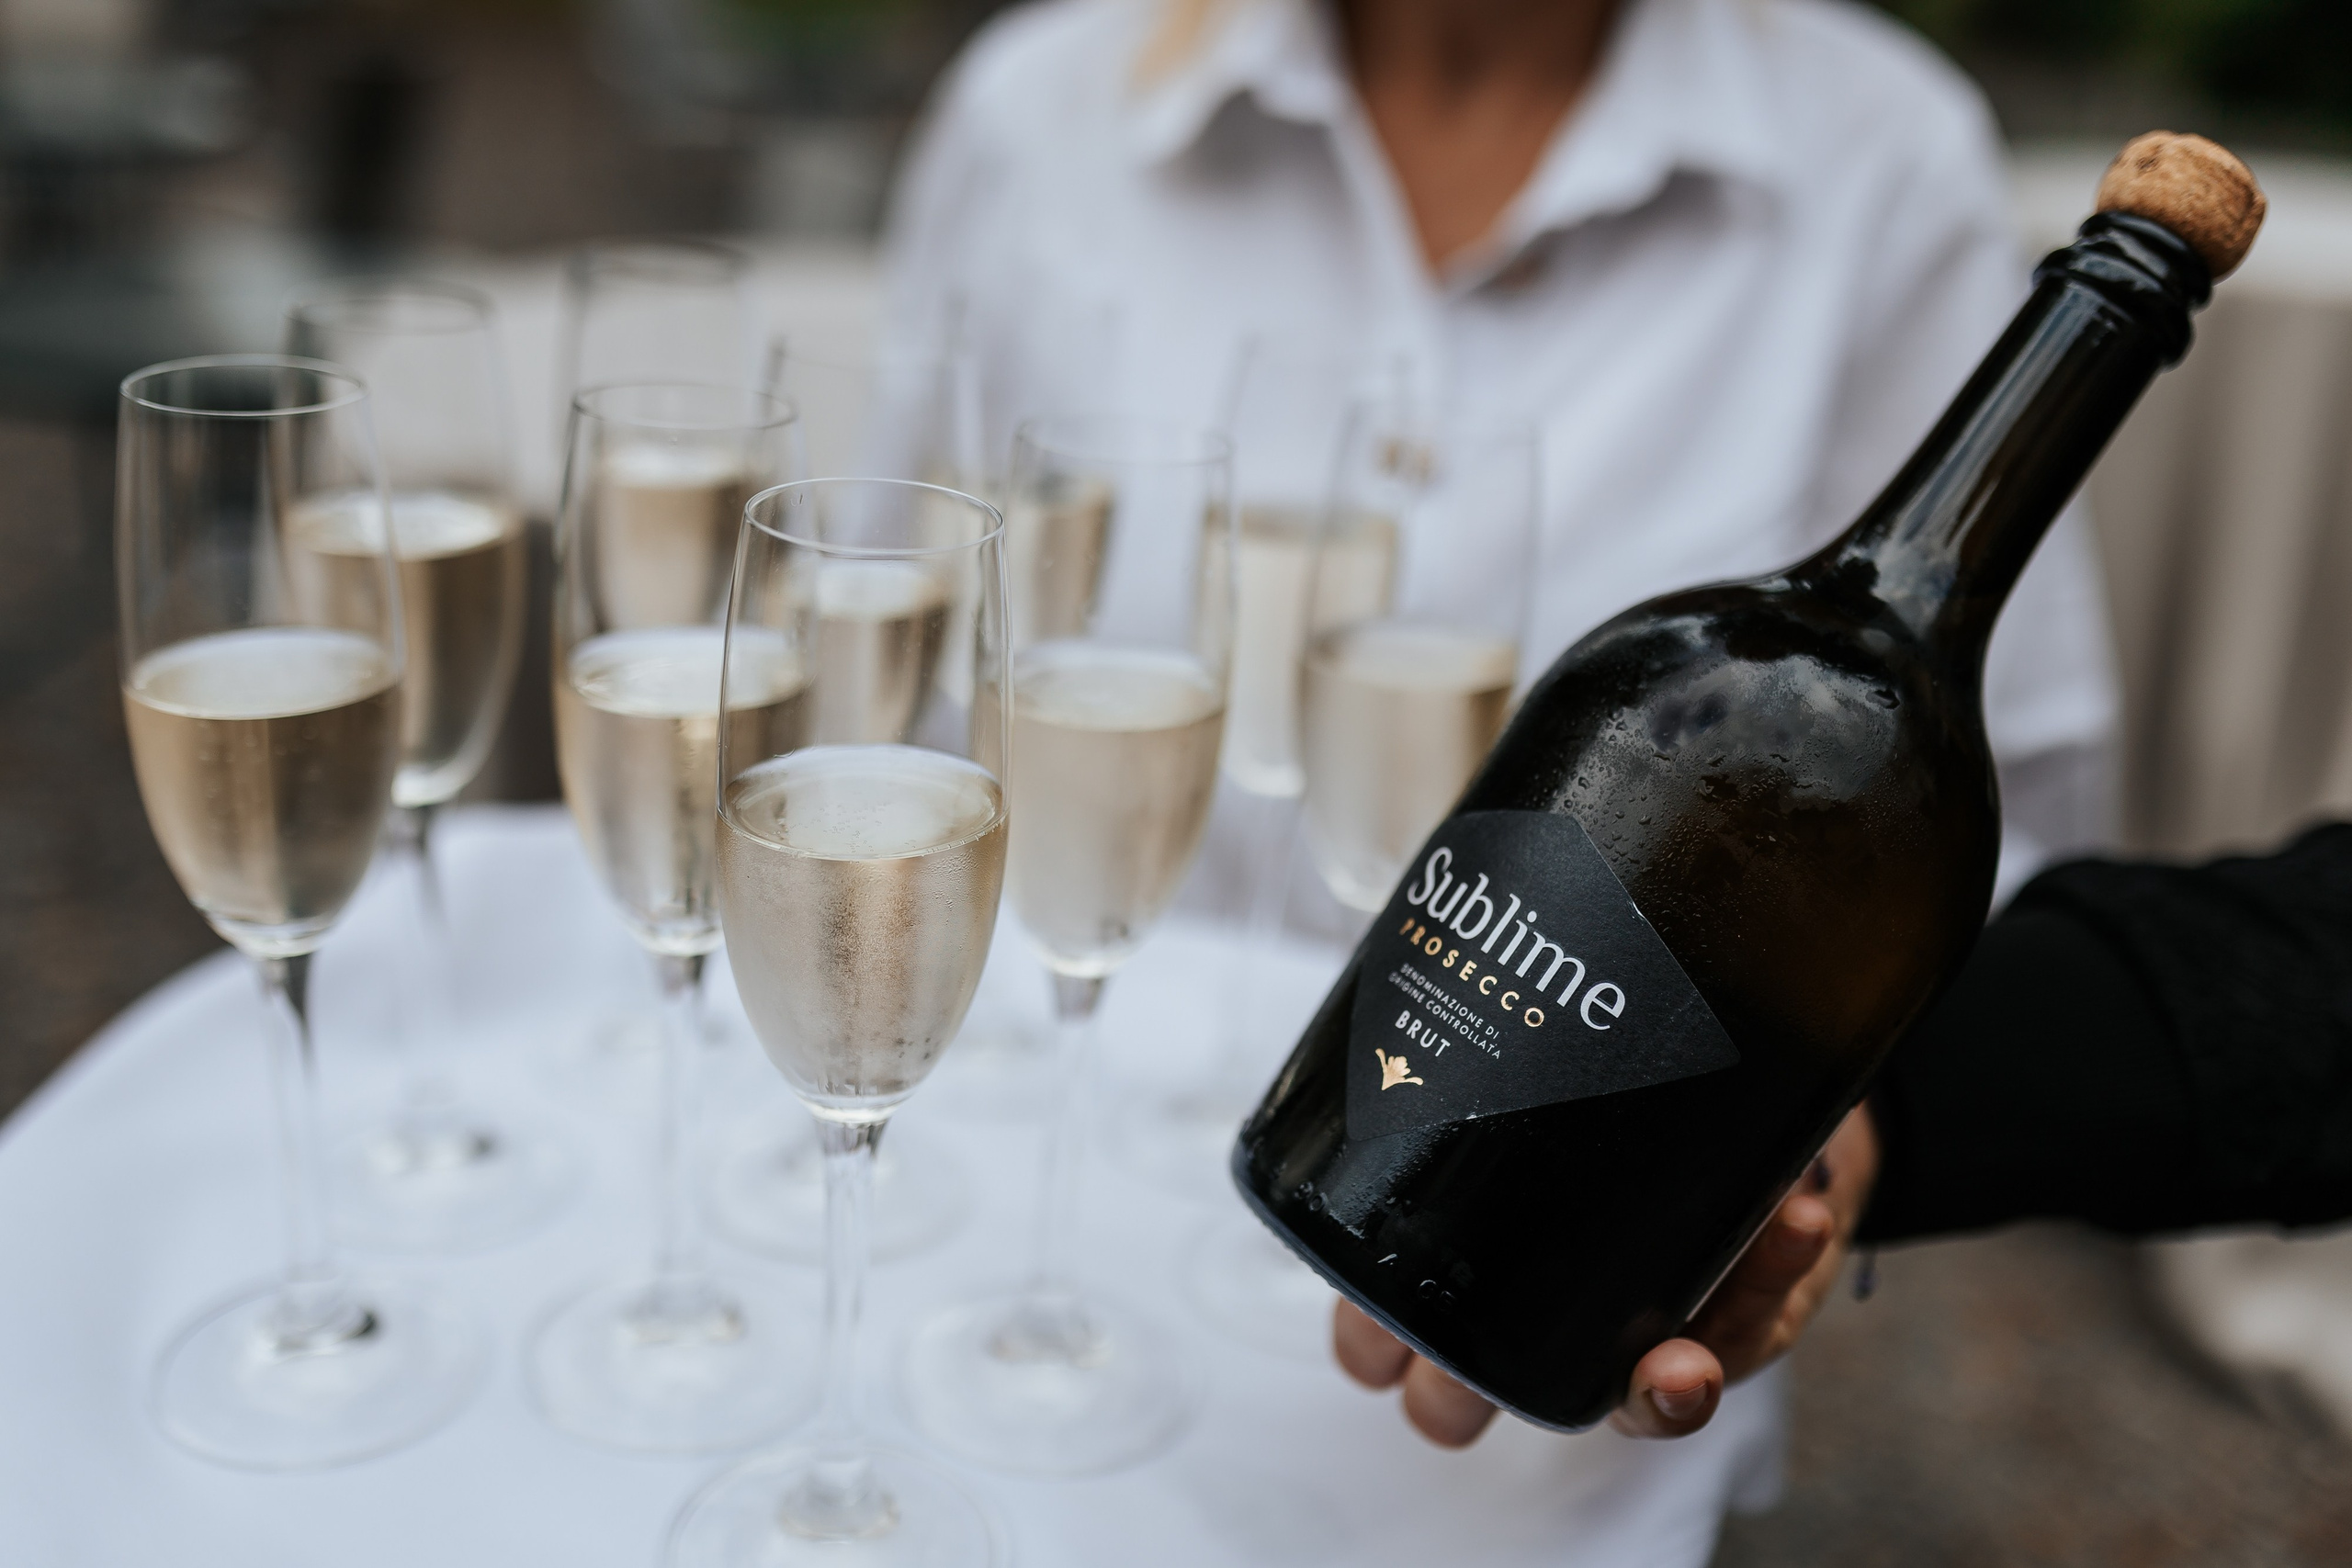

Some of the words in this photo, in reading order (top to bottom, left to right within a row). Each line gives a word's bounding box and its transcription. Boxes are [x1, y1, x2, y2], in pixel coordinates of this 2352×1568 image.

[1399, 918, 1545, 1028] PROSECCO
[1407, 846, 1626, 1031] Sublime
[1388, 971, 1426, 1003] ORIGINE
[1425, 999, 1500, 1059] CONTROLLATA
[1395, 1010, 1452, 1057] BRUT
[1400, 963, 1484, 1029] DENOMINAZIONE
[1486, 1025, 1500, 1039] DI
